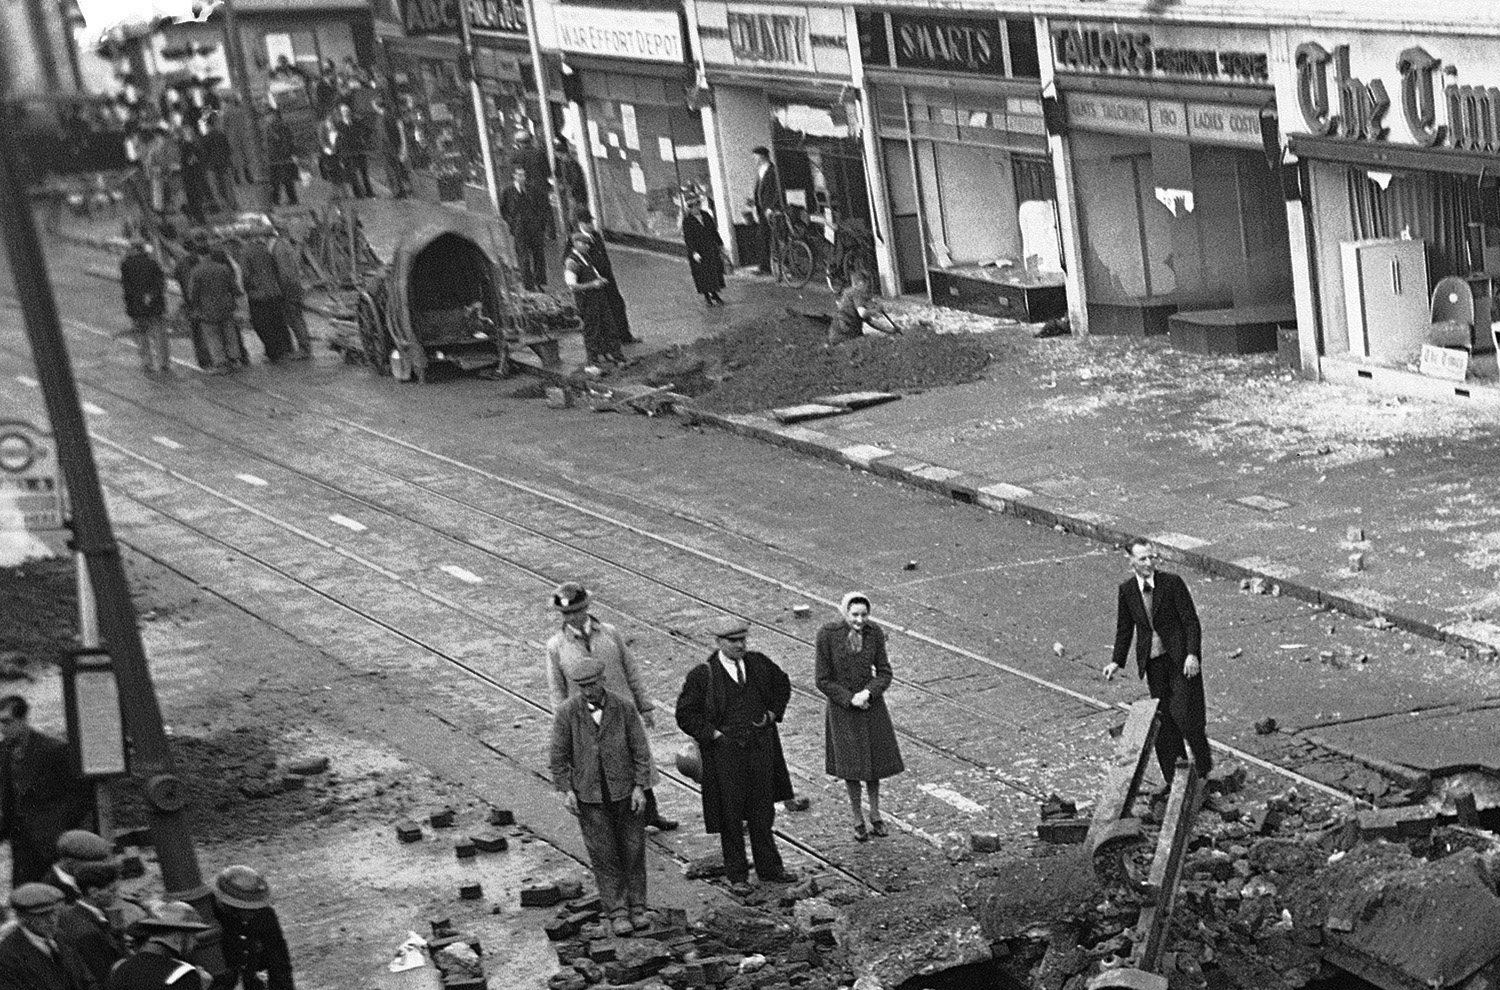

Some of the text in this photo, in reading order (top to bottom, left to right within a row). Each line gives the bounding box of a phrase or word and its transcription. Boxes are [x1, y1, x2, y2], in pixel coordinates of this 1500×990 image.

[588, 26, 634, 53] EFFORT
[635, 29, 679, 56] DEPOT
[1055, 29, 1152, 75] TAILORS
[1295, 40, 1391, 138] The
[1228, 113, 1262, 135] COSTU
